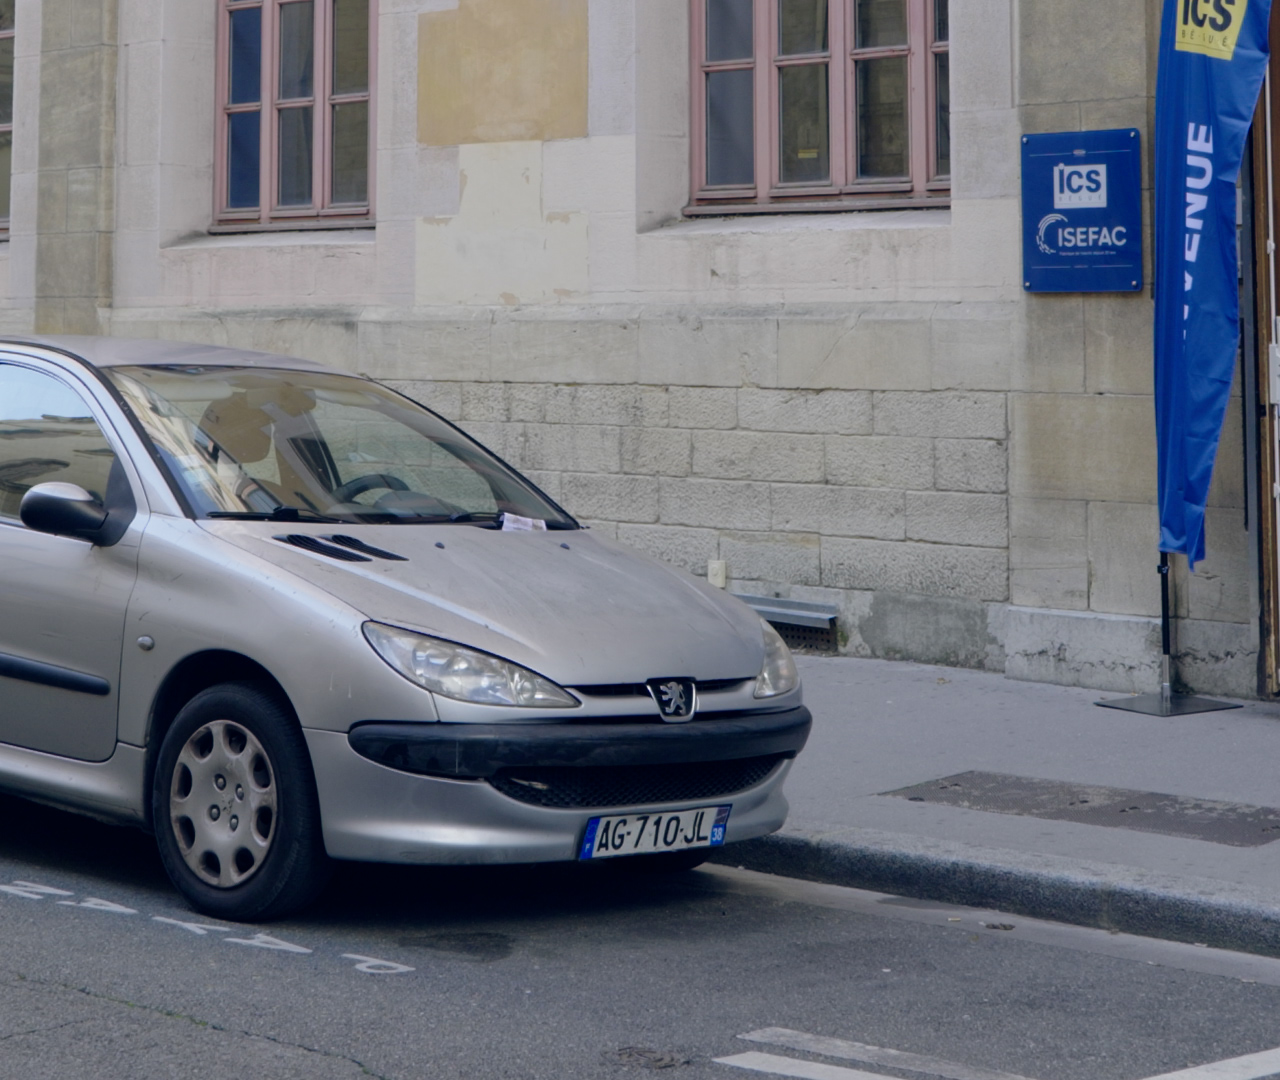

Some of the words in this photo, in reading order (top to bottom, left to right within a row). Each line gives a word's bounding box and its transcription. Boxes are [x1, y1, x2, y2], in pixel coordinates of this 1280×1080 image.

[1058, 226, 1126, 247] ISEFAC
[596, 811, 709, 852] AG-710-JL
[712, 827, 723, 841] 38
